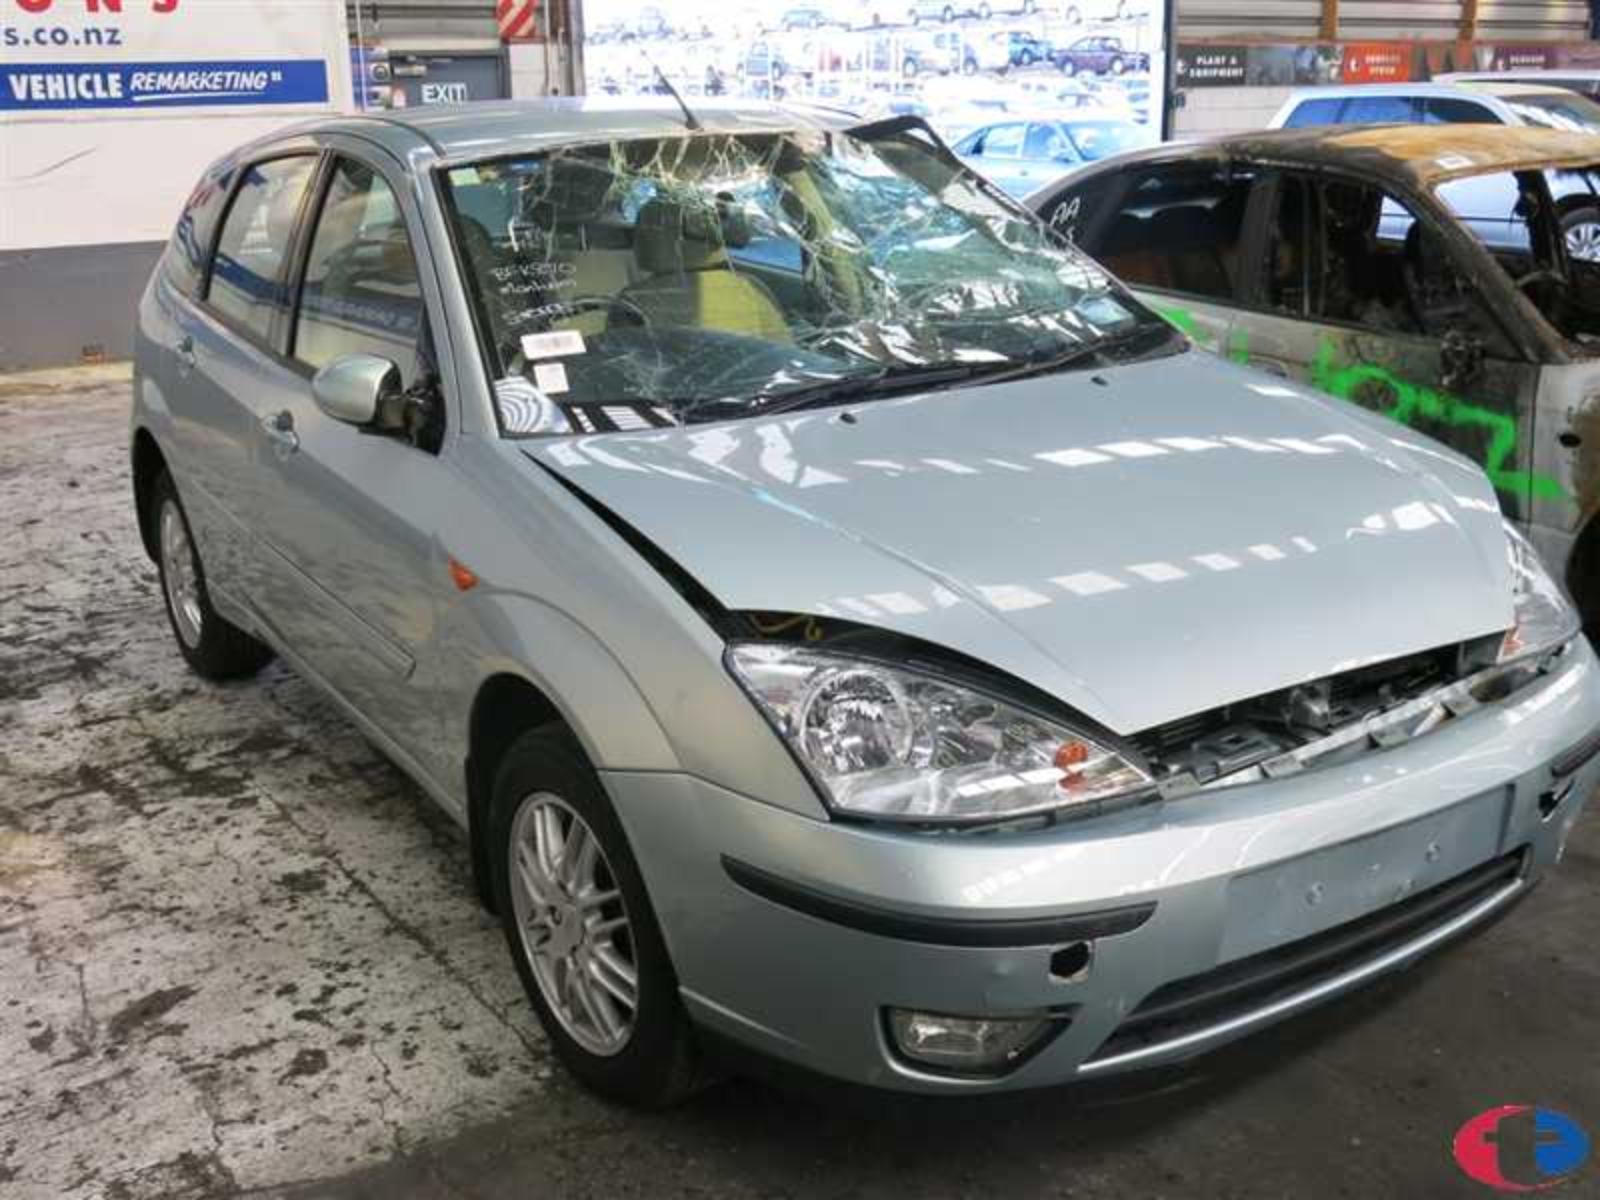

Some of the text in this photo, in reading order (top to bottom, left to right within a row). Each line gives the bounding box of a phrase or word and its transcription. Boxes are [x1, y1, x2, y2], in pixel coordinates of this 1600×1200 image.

[4, 27, 122, 45] s.co.nz
[1189, 67, 1243, 78] EQUIPMENT
[8, 72, 123, 101] VEHICLE
[421, 83, 467, 104] EXIT
